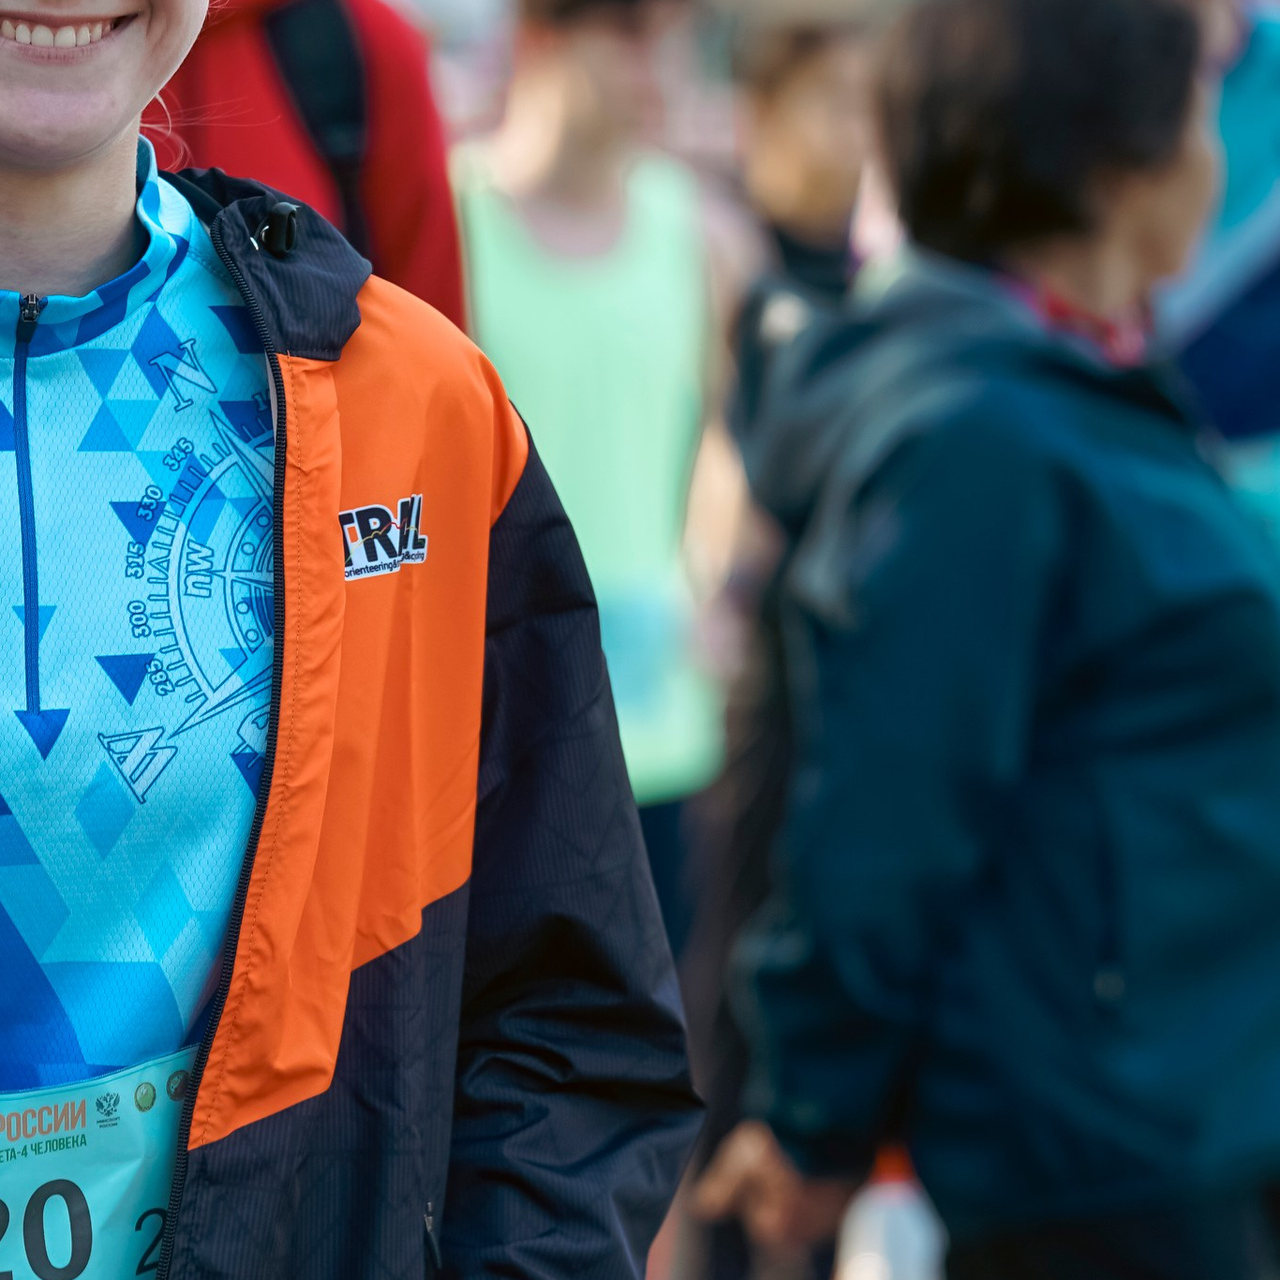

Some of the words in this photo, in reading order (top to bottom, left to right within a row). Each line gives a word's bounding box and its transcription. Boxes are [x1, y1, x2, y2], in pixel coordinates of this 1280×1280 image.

[148, 338, 218, 412] N
[163, 437, 194, 471] 345
[136, 485, 163, 521] 330
[125, 541, 146, 579] 315
[127, 600, 151, 638] 300
[145, 658, 175, 696] 285
[98, 726, 178, 804] W
[30, 1134, 87, 1157] ЧЕЛОВЕКА
